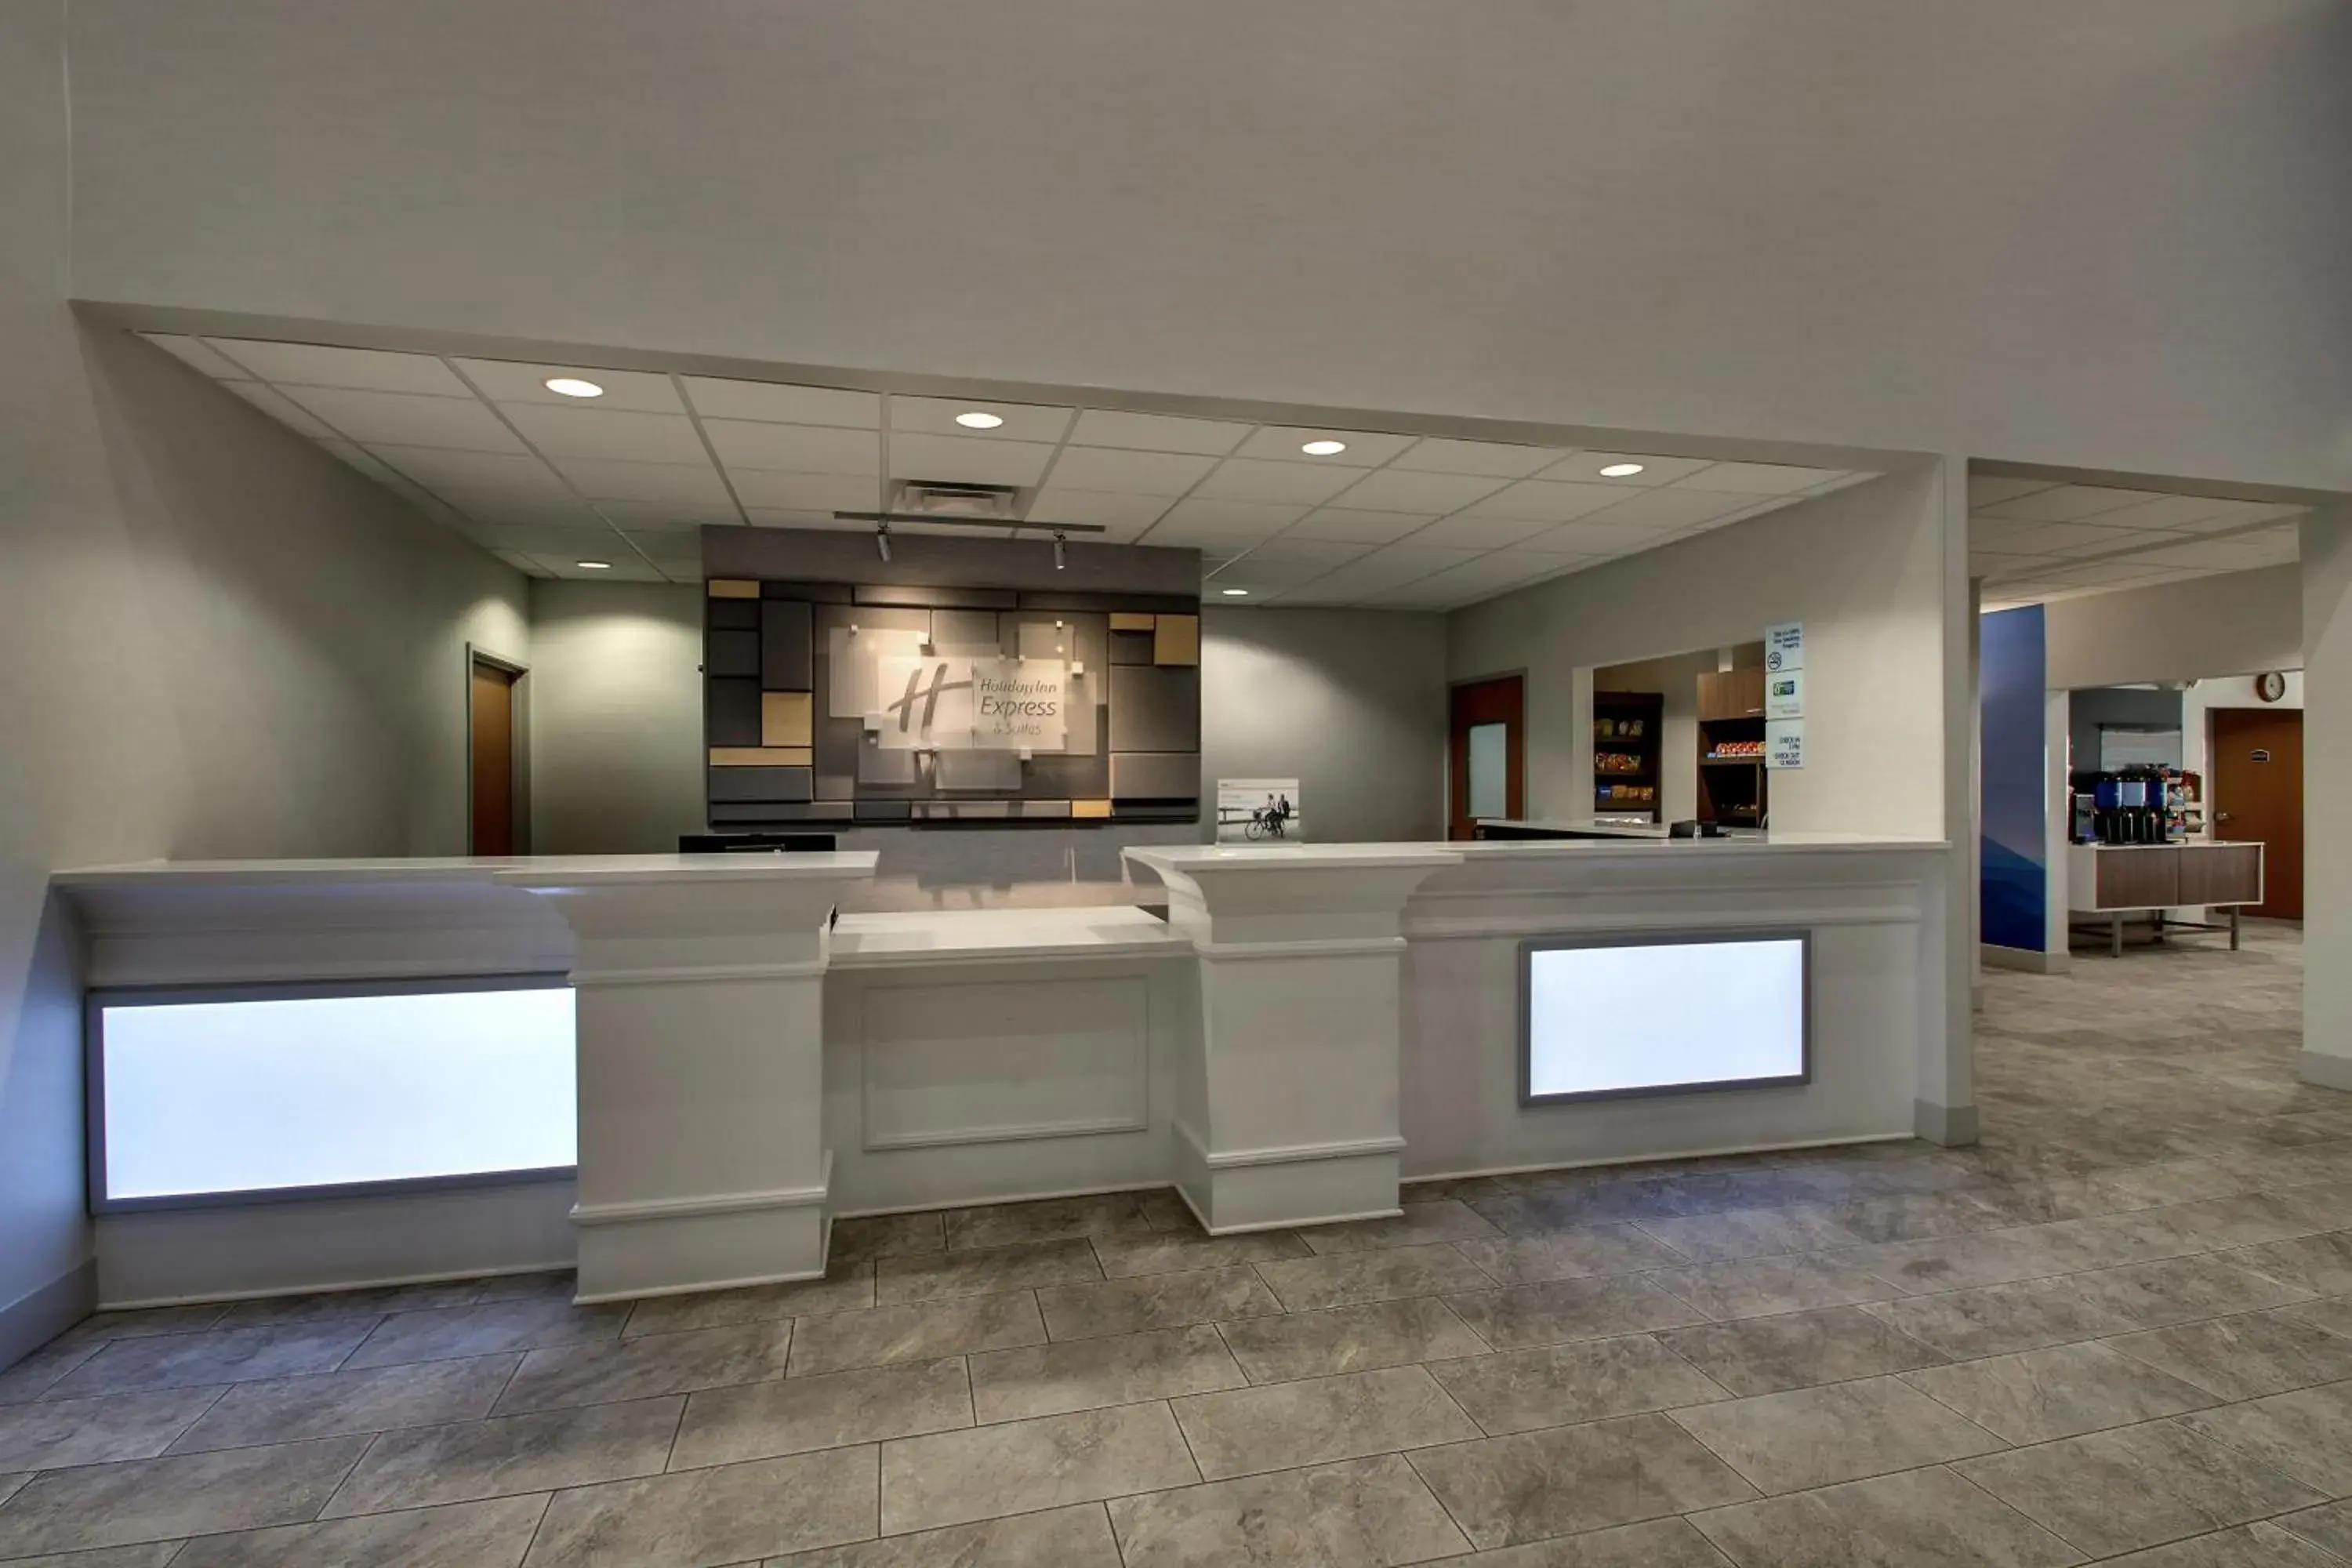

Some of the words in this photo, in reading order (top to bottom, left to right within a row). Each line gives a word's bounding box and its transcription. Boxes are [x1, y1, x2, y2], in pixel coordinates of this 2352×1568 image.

[980, 677, 1032, 697] Holiday
[1035, 679, 1058, 694] Inn
[981, 695, 1057, 721] Express
[1004, 721, 1043, 736] Suites
